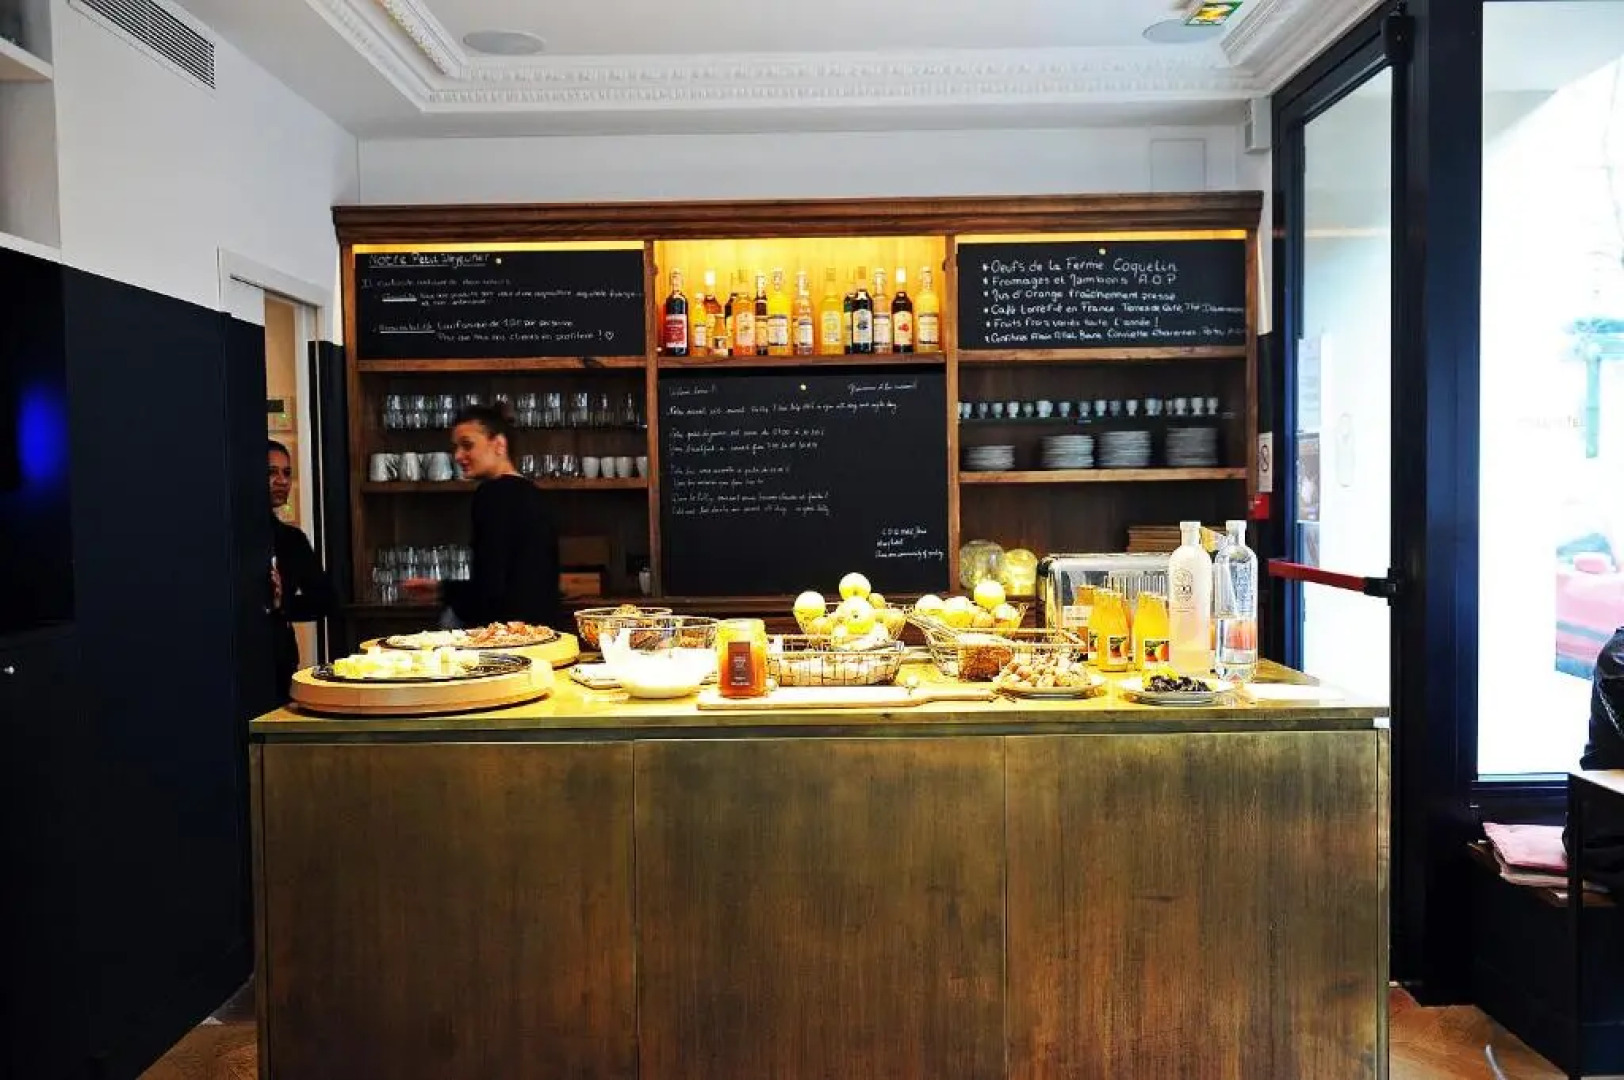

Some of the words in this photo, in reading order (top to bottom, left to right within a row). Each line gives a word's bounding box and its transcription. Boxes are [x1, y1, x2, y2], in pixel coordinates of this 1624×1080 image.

[411, 253, 438, 265] Petit
[991, 259, 1025, 274] Oeufs
[1028, 260, 1043, 272] de
[1049, 259, 1062, 271] la
[1066, 256, 1105, 271] Ferme
[992, 275, 1050, 289] Fromages
[1054, 275, 1066, 285] et
[991, 288, 1010, 302] Jus
[1065, 304, 1078, 313] en
